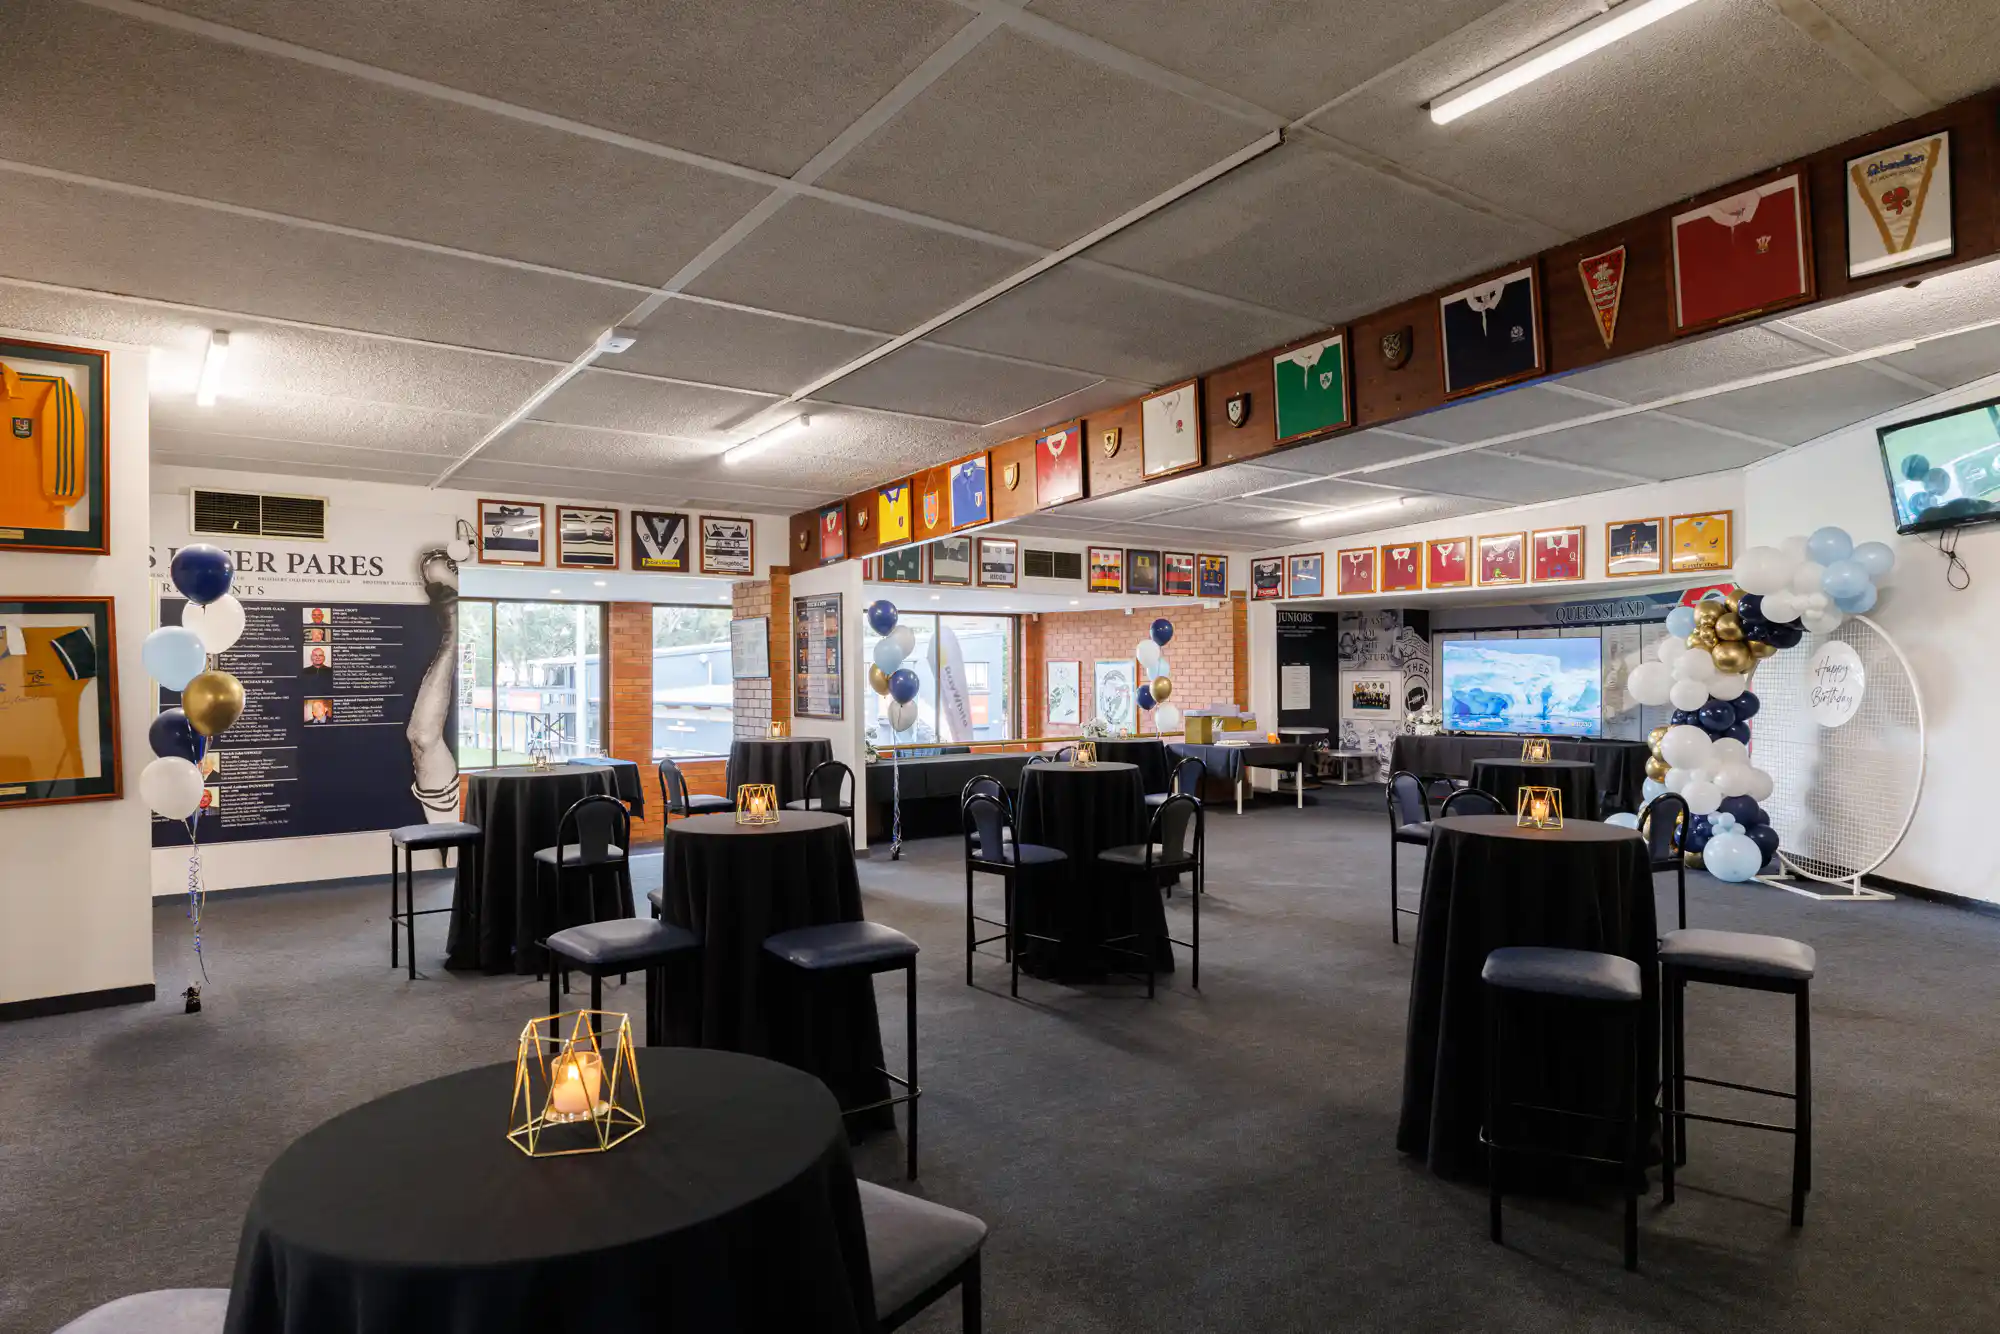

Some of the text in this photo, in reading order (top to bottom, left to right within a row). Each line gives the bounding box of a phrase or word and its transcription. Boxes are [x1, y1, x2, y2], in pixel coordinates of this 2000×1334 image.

[286, 552, 384, 577] PARES
[1278, 612, 1313, 624] JUNIORS
[1555, 600, 1646, 625] QUEENSLAND
[1814, 655, 1848, 685] Happy
[1811, 686, 1853, 713] Birthday
